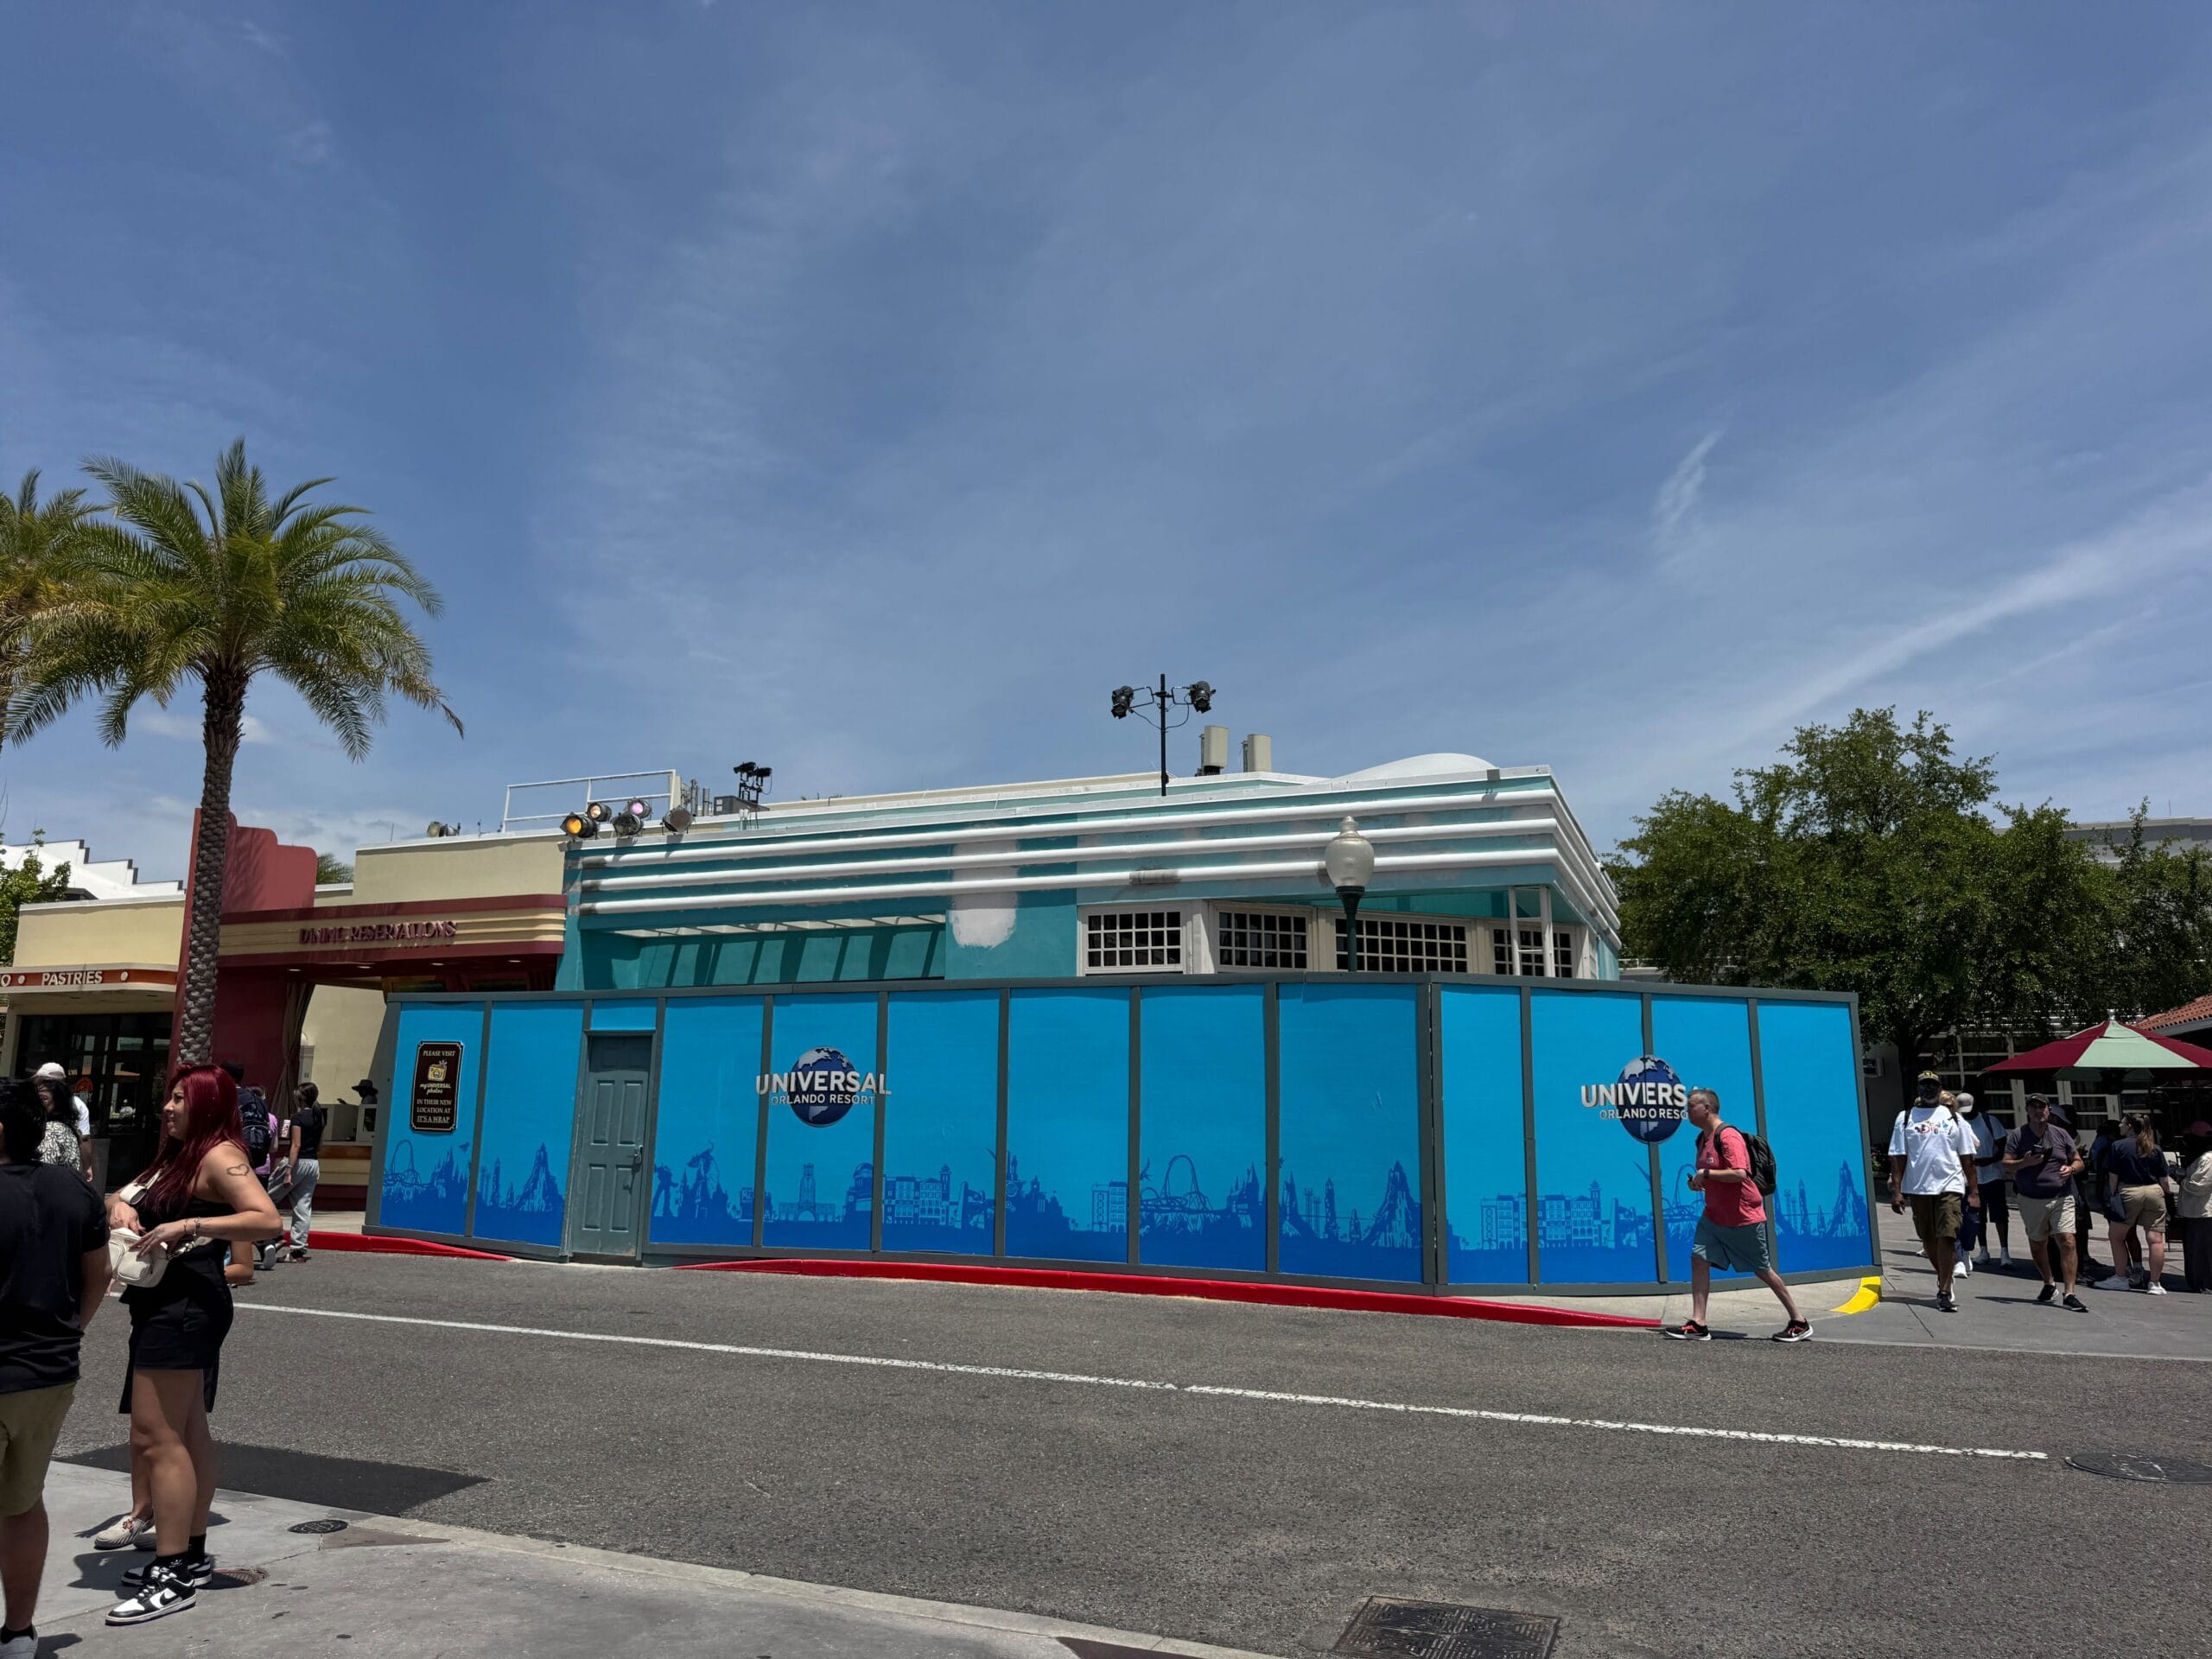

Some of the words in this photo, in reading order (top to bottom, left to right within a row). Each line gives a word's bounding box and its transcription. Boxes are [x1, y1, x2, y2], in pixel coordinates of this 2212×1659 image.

[350, 920, 457, 942] RESERVATIONS
[41, 970, 103, 985] PASTRIES
[756, 1071, 892, 1096] UNIVERSAL
[771, 1094, 825, 1105] ORLANDO
[830, 1094, 875, 1105] RESORT
[1580, 1083, 1699, 1108] UNIVERS
[1599, 1109, 1657, 1120] ORLANDO
[1659, 1109, 1688, 1120] RESO
